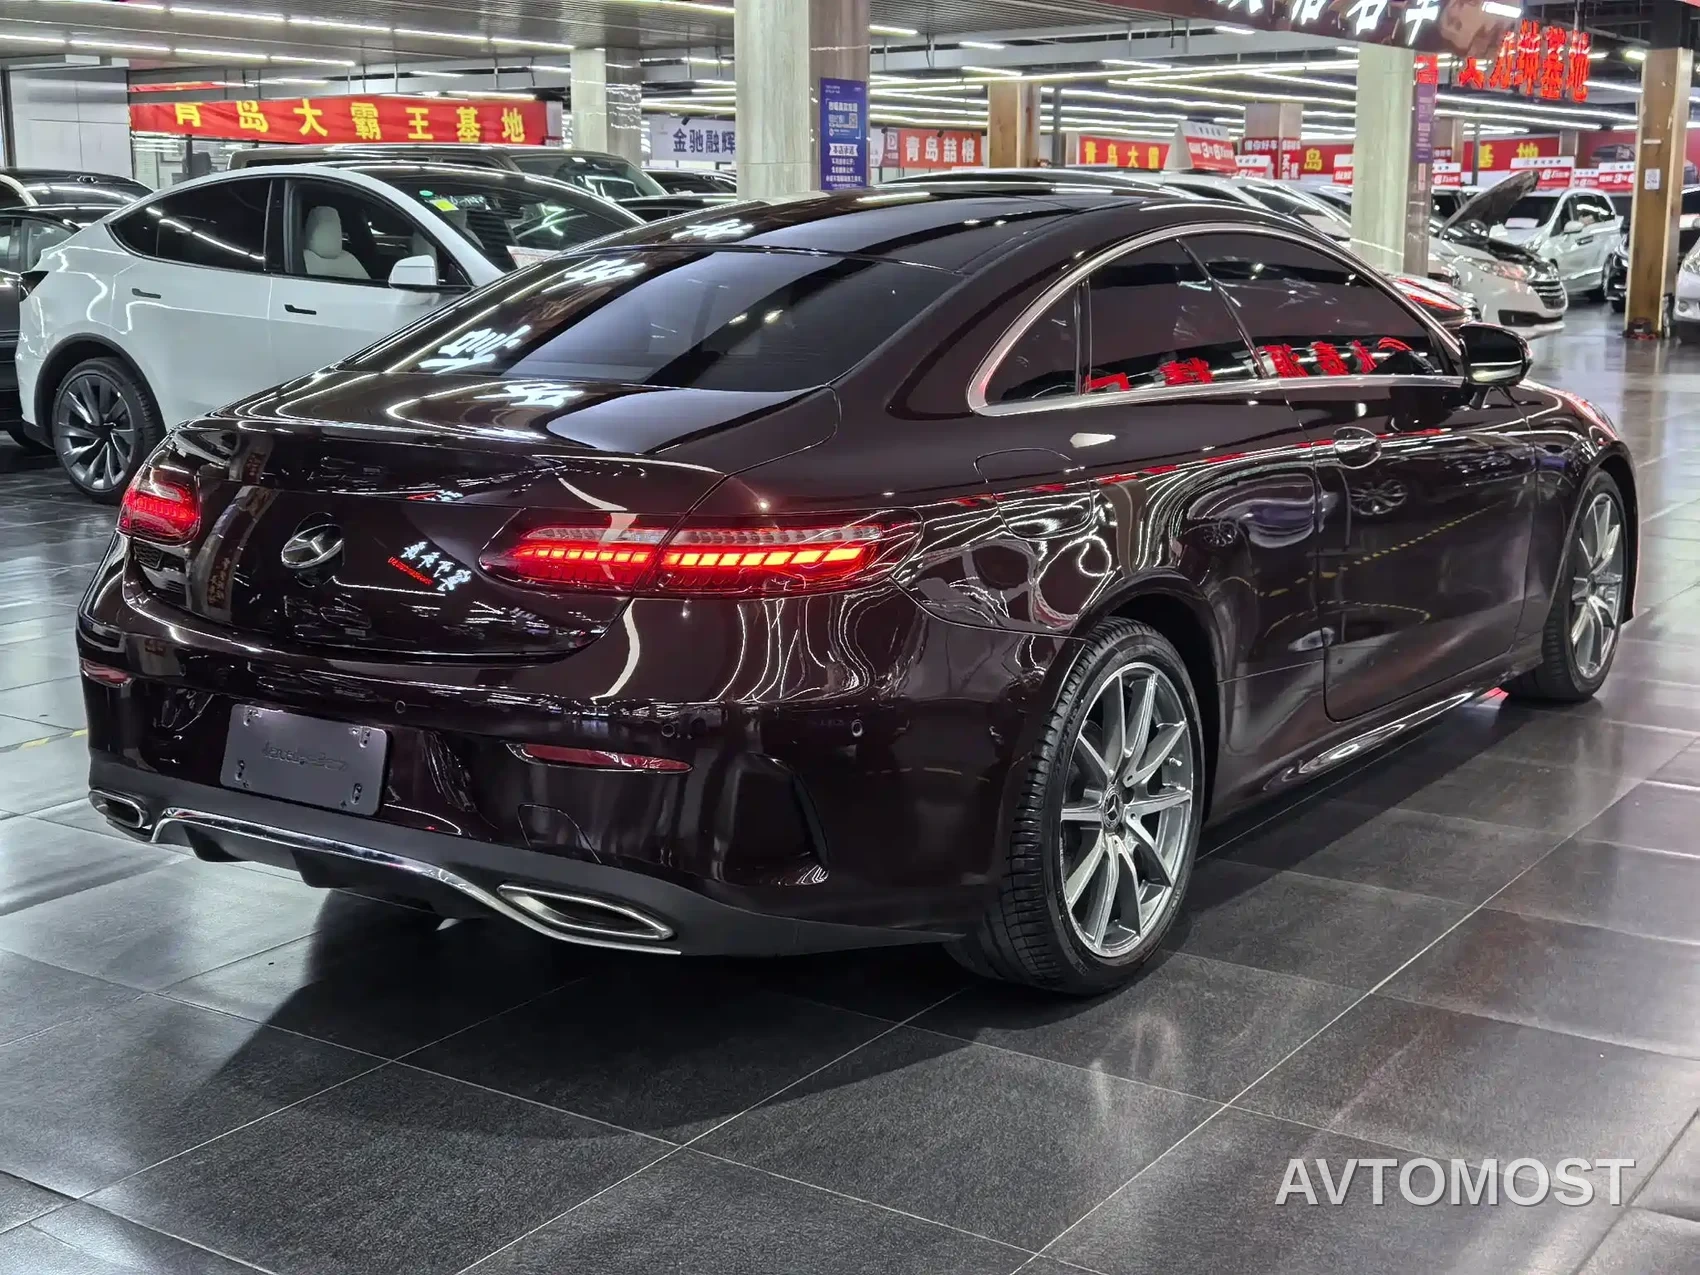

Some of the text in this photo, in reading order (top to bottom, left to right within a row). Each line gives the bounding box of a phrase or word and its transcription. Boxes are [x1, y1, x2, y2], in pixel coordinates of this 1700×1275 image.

[174, 98, 526, 143] 青岛大霸王基地
[672, 128, 735, 154] 金驰融辉
